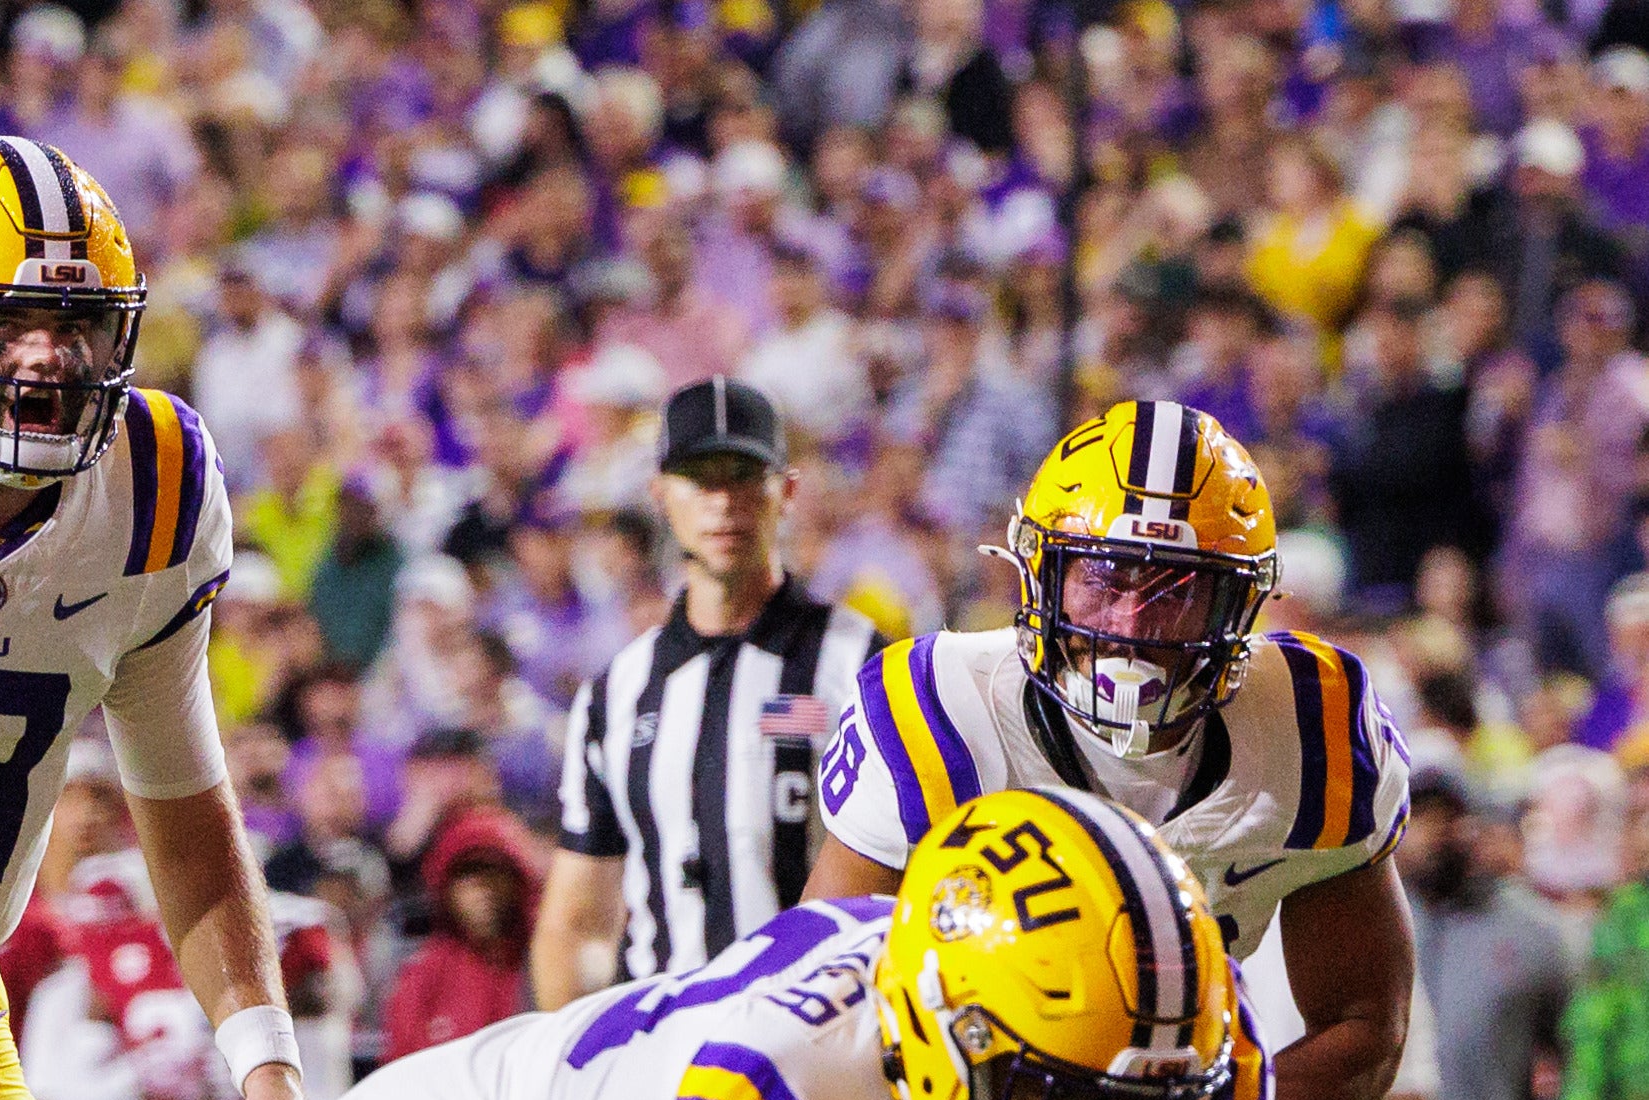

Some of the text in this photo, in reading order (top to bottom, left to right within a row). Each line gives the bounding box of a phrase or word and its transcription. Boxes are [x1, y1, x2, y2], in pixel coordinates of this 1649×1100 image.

[40, 264, 86, 283] LSU
[1131, 519, 1181, 540] LSU
[773, 769, 812, 823] C
